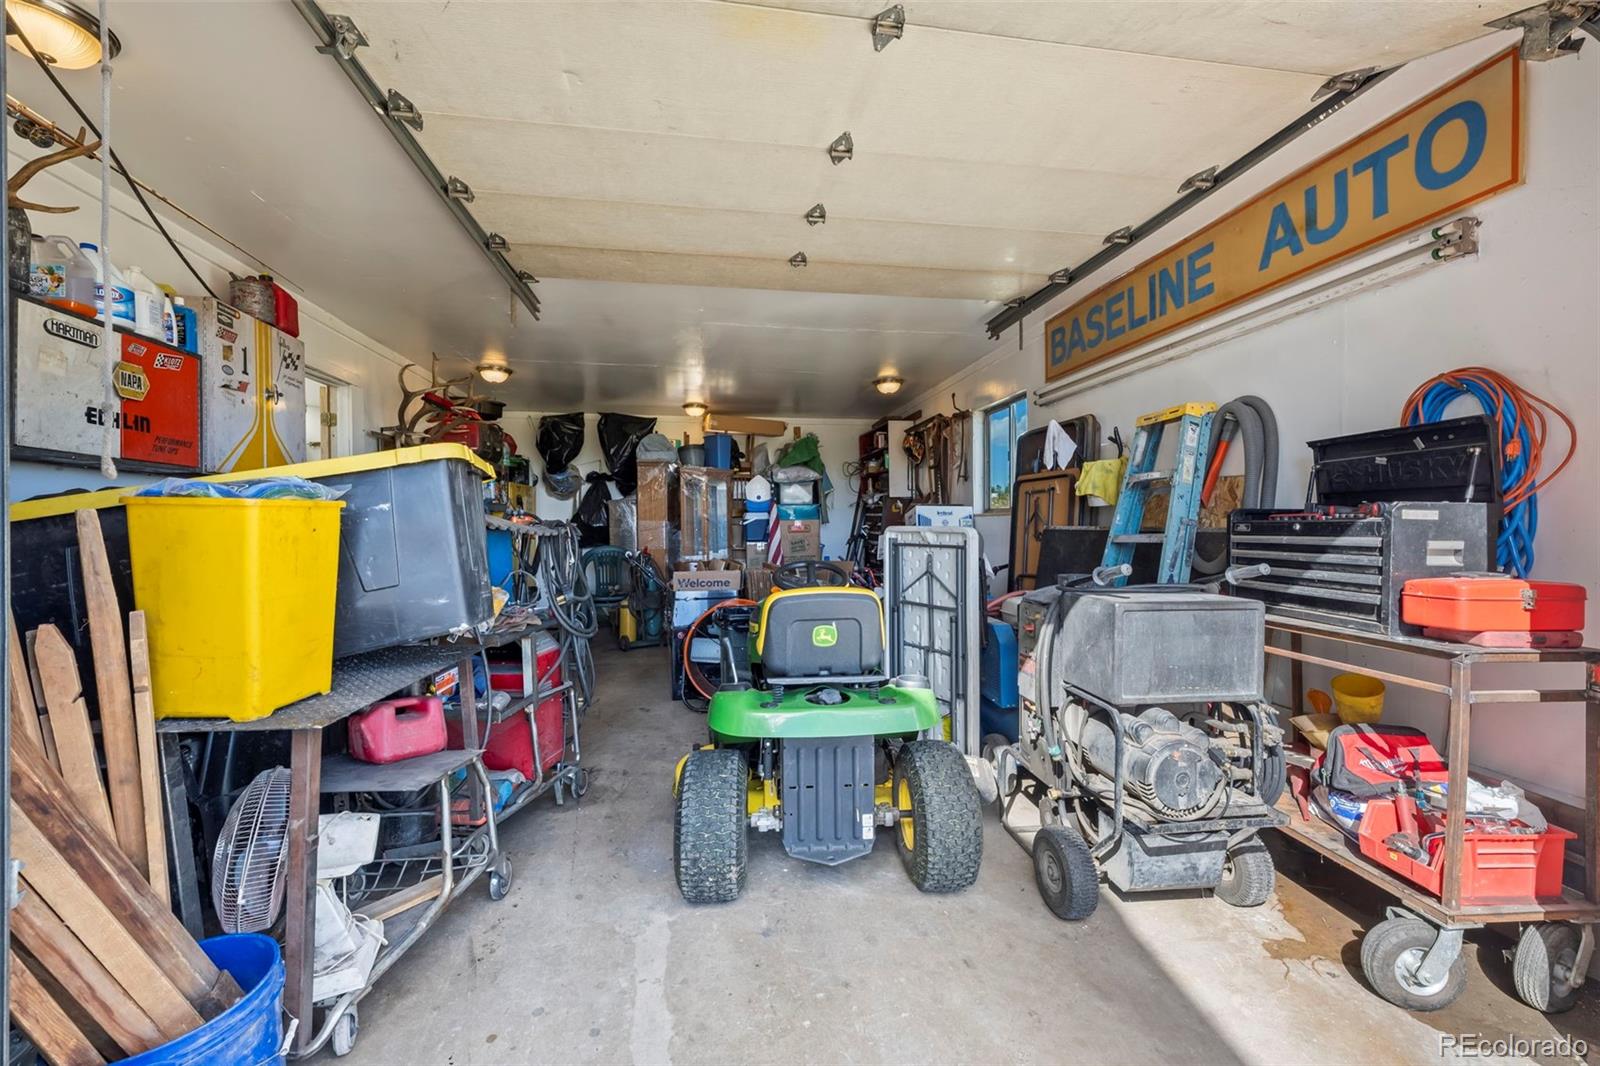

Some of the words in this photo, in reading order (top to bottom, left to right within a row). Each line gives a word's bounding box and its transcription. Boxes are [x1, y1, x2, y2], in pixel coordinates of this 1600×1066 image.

[1050, 242, 1215, 367] BASELINE
[1258, 100, 1488, 272] AUTO
[51, 320, 99, 346] HARTMAN
[120, 372, 143, 390] NAPA
[678, 578, 731, 588] Welcome
